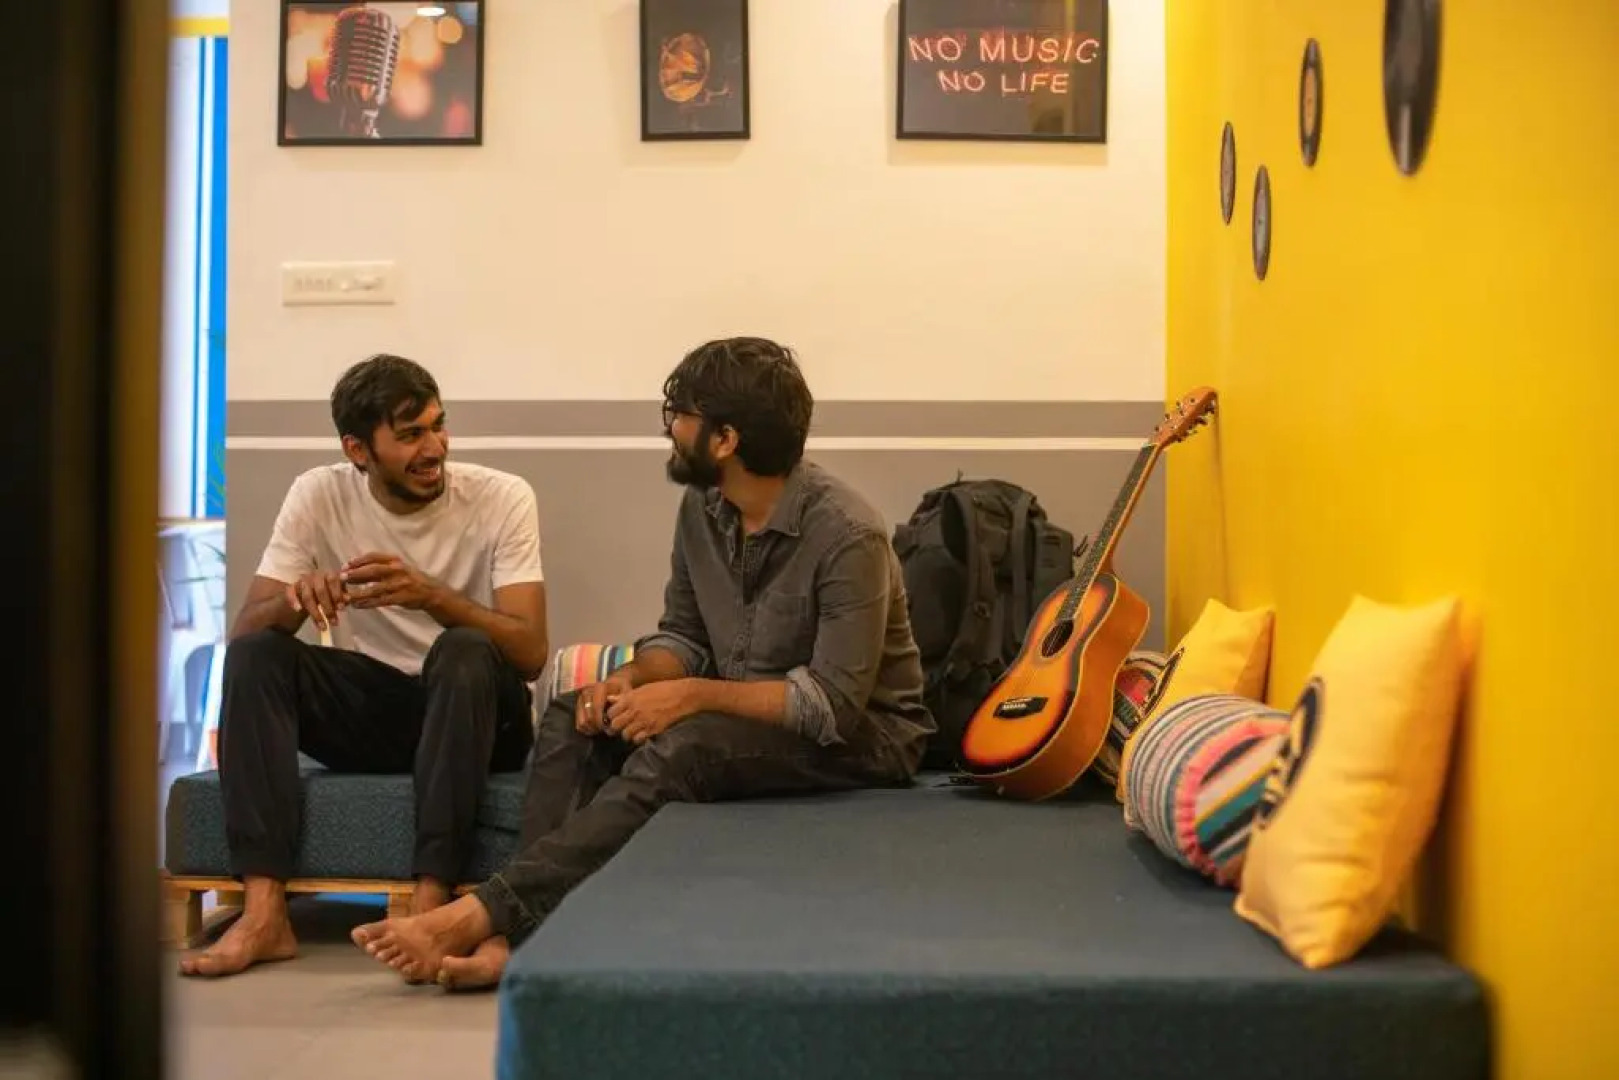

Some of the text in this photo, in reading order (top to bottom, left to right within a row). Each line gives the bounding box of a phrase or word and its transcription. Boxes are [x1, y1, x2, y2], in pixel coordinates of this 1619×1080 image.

[908, 36, 1099, 63] NO MUSIC
[938, 70, 1069, 93] NO LIFE
